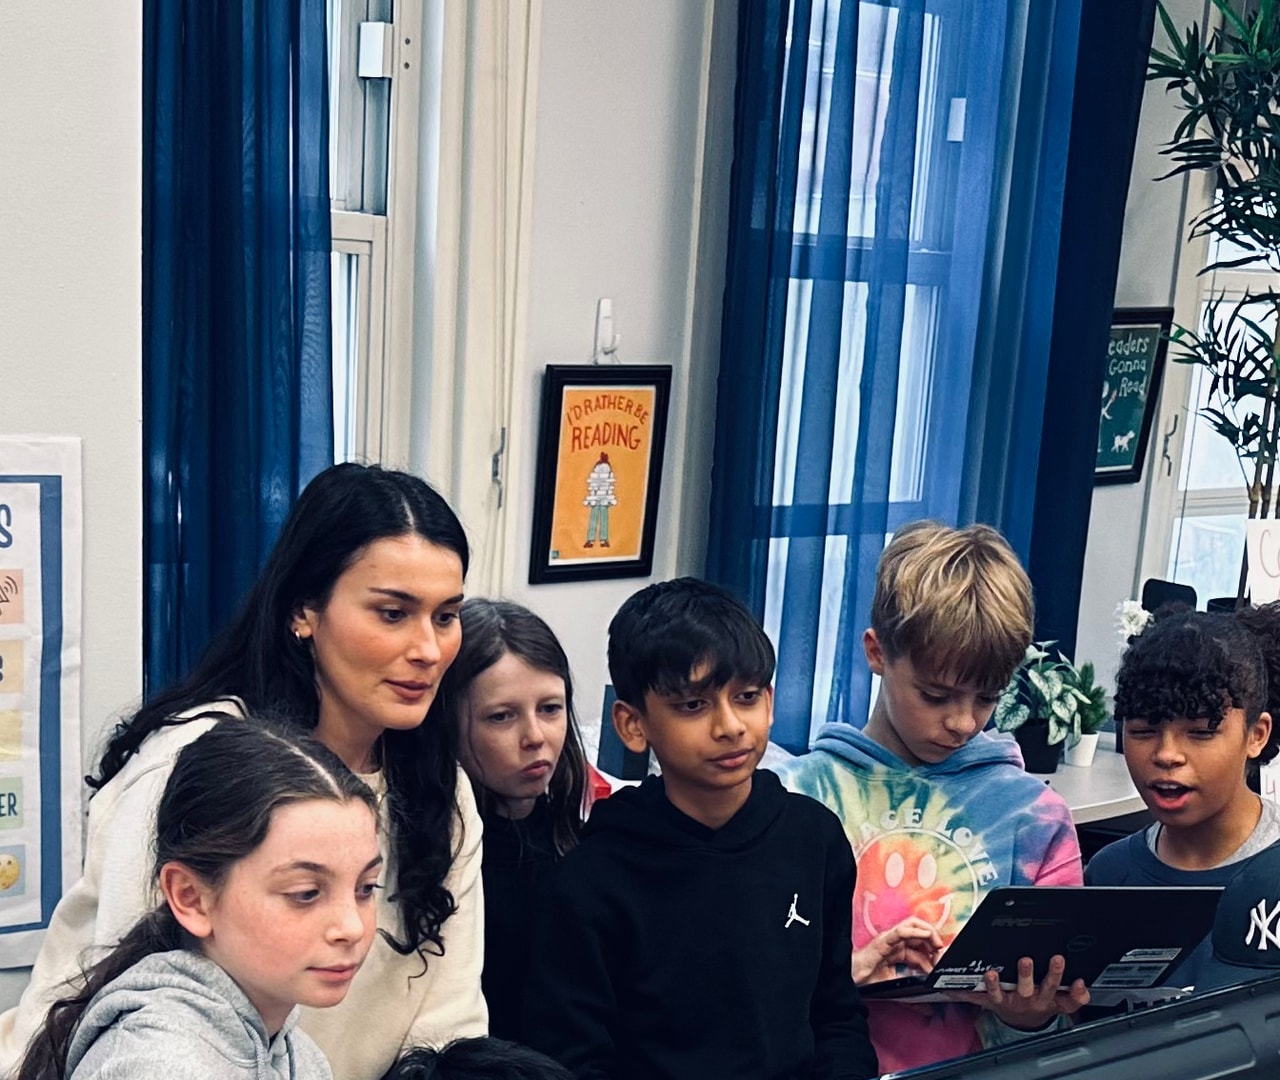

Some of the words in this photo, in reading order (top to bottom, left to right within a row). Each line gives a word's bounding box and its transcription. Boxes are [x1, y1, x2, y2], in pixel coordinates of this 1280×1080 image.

[1108, 332, 1150, 356] eaders
[1109, 358, 1147, 376] Gonna
[1119, 375, 1147, 397] Read
[584, 394, 632, 417] RATHER
[634, 404, 650, 426] BE
[571, 422, 641, 452] READING
[935, 806, 999, 887] LOVE
